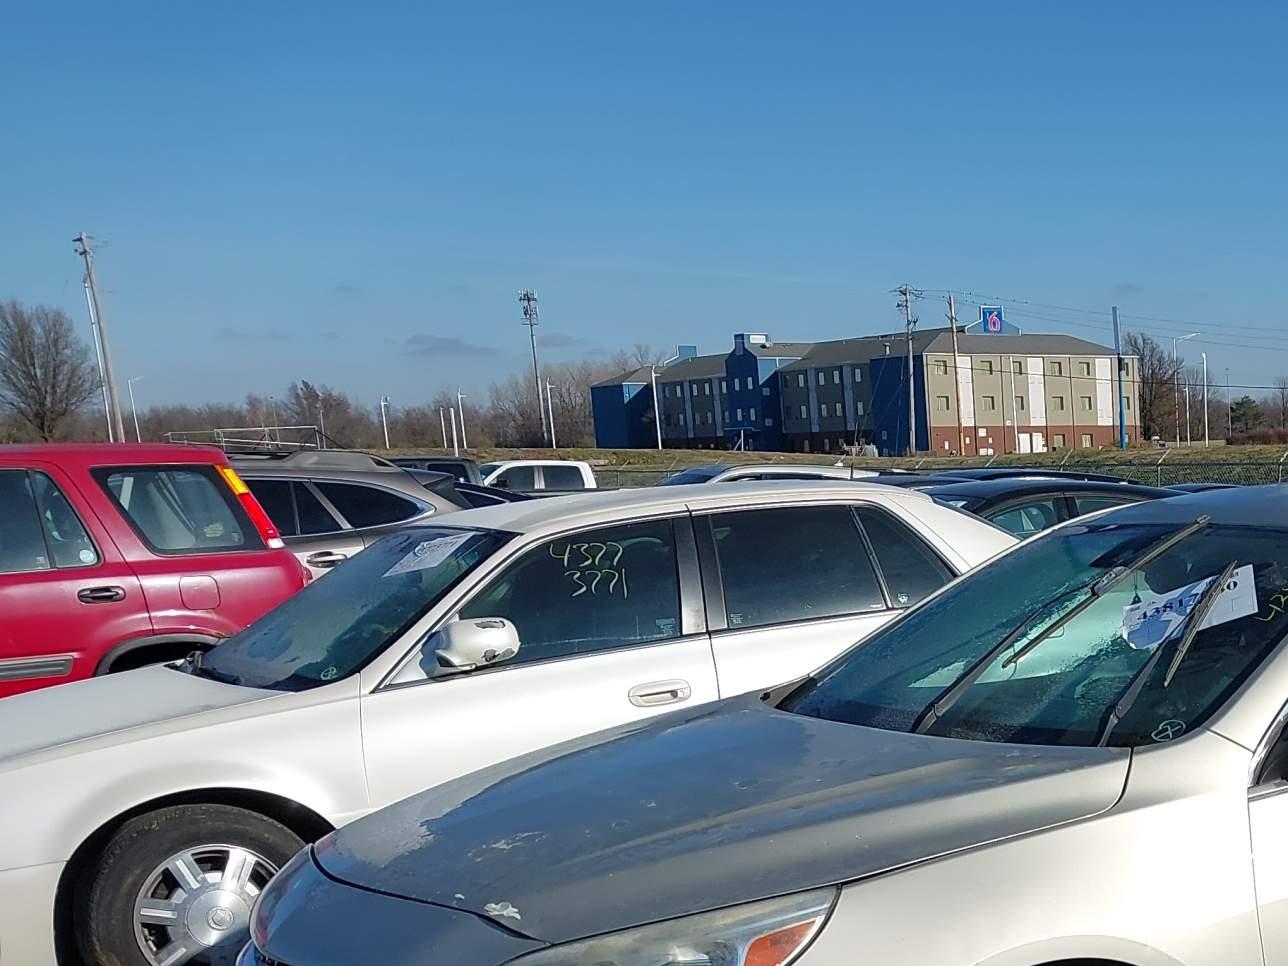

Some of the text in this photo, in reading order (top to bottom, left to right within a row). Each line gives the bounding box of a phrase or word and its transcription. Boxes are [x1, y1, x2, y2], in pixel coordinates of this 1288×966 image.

[988, 311, 1001, 332] 6
[549, 542, 623, 567] 4377
[564, 568, 628, 599] 3771
